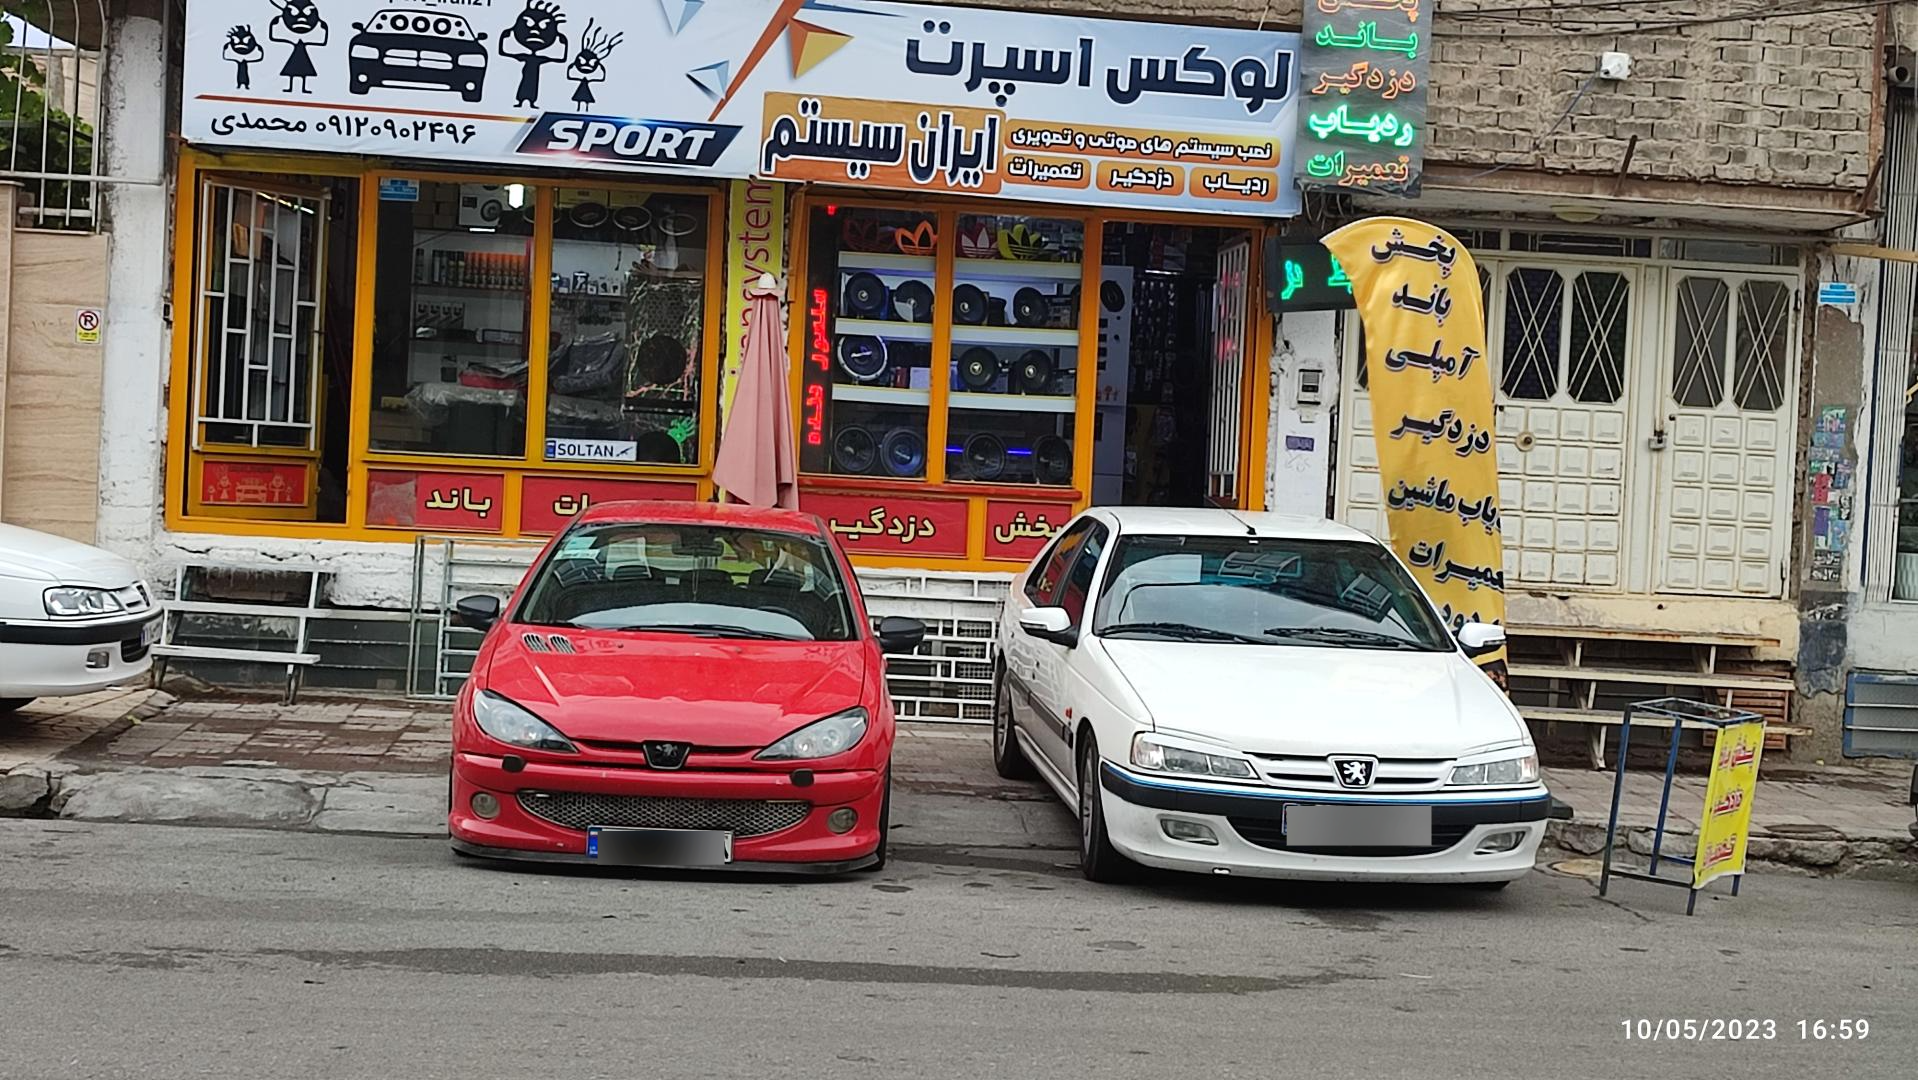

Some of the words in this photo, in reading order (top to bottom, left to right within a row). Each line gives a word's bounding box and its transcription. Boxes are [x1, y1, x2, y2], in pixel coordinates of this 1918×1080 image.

[1315, 21, 1419, 59] باند
[906, 19, 1095, 106] اسپرت
[1107, 47, 1293, 113] لوکس
[1312, 61, 1416, 100] دزدگیر
[211, 112, 307, 135] محمدی
[547, 119, 716, 160] SPORT
[761, 97, 902, 178] سیستم
[1011, 126, 1073, 147] تصویری
[1074, 132, 1086, 149] و
[1308, 104, 1415, 146] ردیاب
[910, 112, 998, 186] ایران
[1089, 132, 1138, 153] صوتی
[1141, 134, 1174, 155] های
[1175, 136, 1235, 160] سیستم
[1239, 142, 1273, 160] نصب
[1008, 160, 1083, 182] تعمیرات
[1204, 171, 1269, 195] ردیاب
[1307, 150, 1410, 187] تعمیرات
[1371, 228, 1457, 277] پخش
[1391, 283, 1452, 326] باند
[1384, 340, 1482, 382] آمپلی
[557, 443, 614, 458] SOLTAN
[1389, 409, 1490, 455] دزدگیر
[425, 487, 493, 518] باند
[1387, 476, 1455, 512] ماشین
